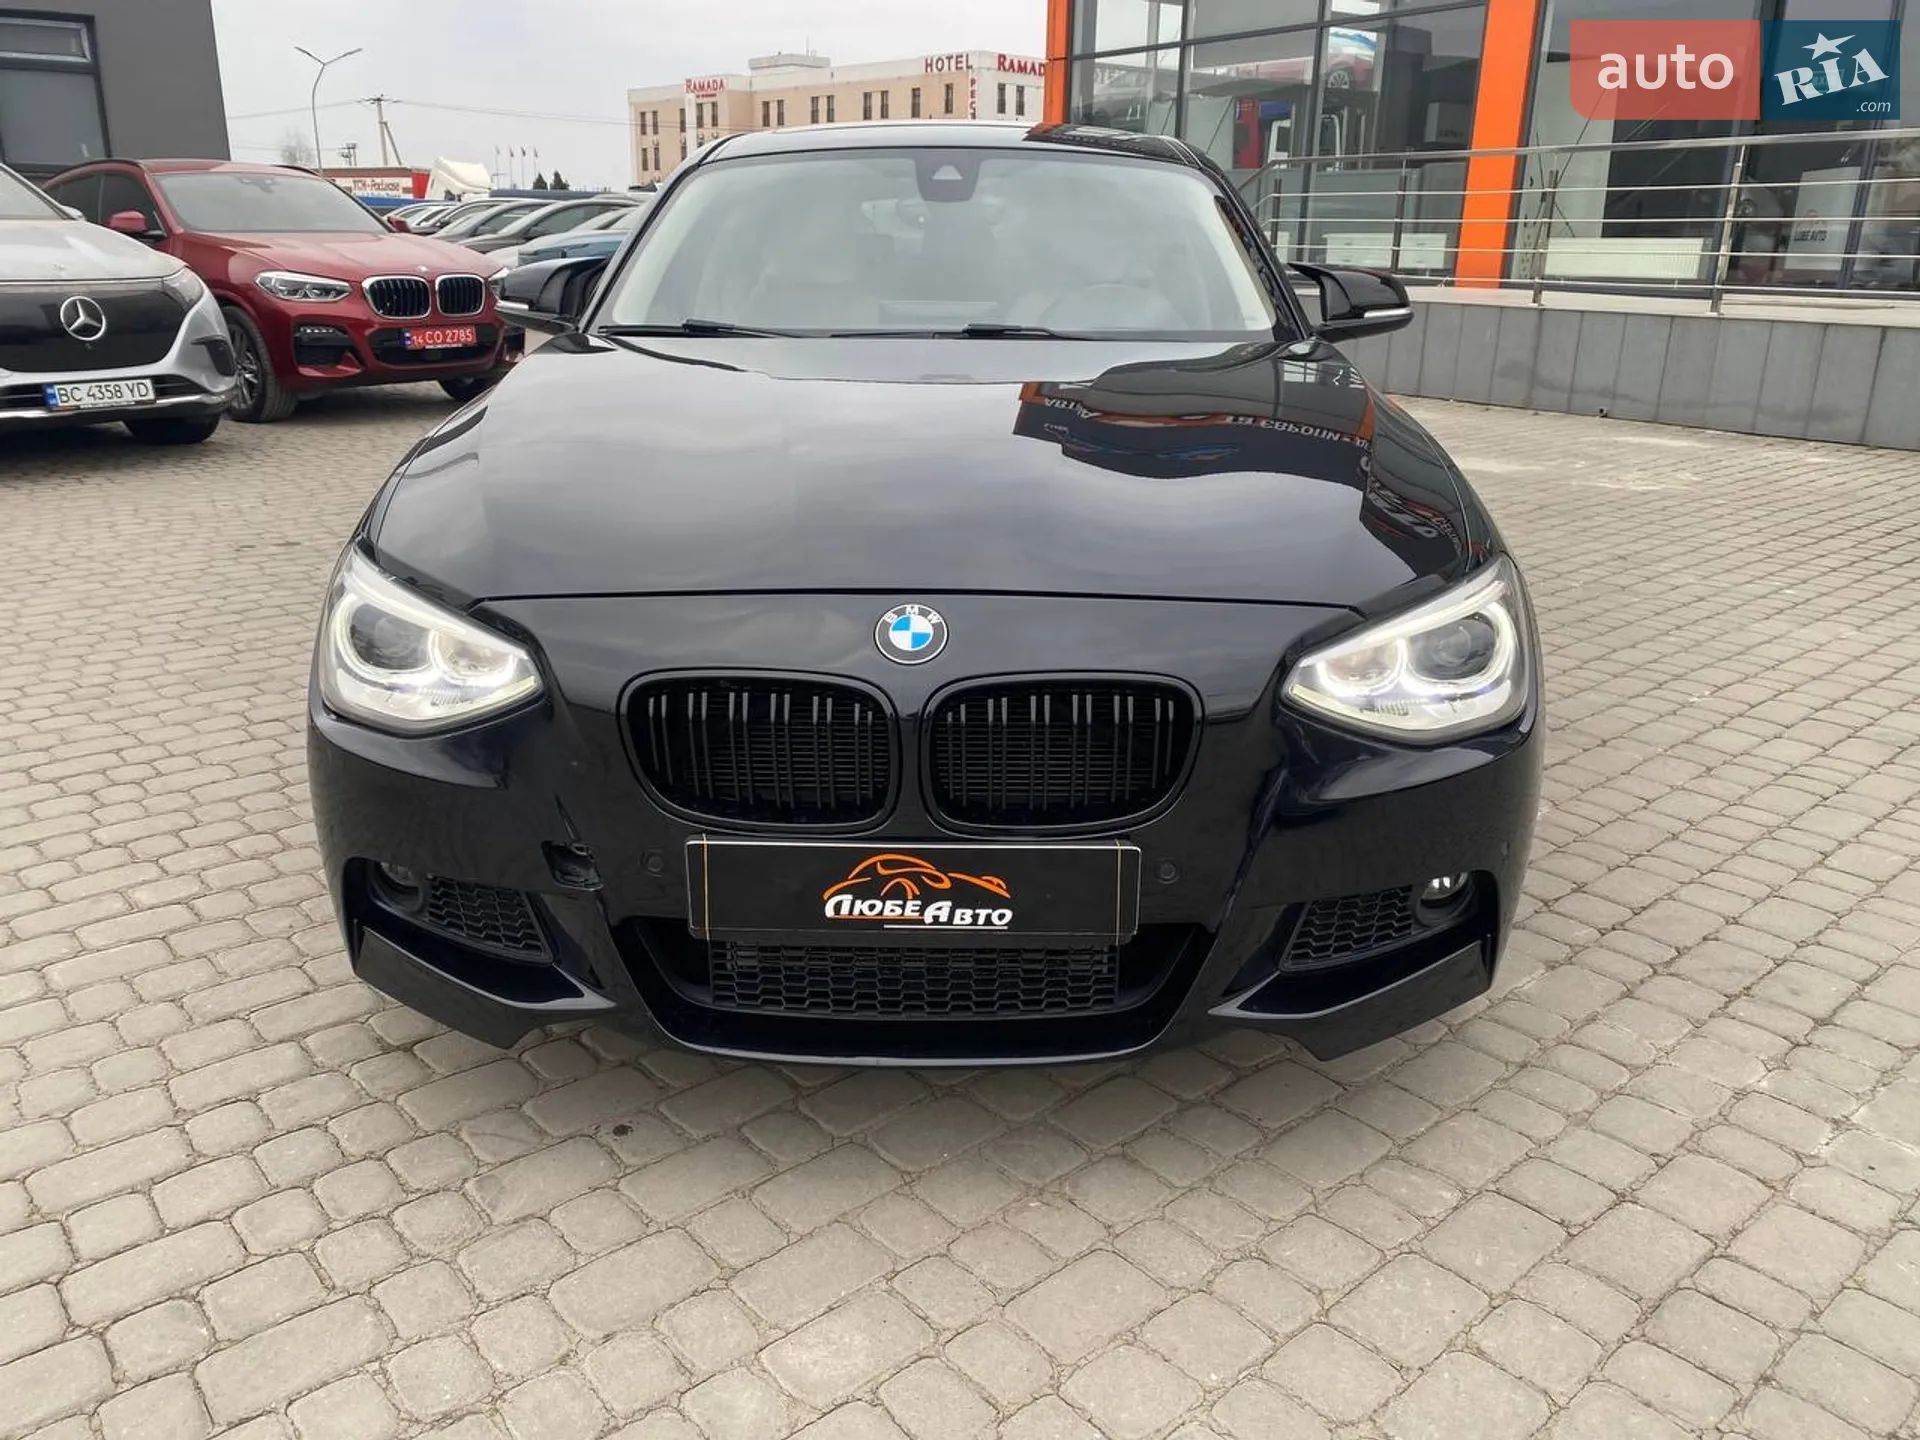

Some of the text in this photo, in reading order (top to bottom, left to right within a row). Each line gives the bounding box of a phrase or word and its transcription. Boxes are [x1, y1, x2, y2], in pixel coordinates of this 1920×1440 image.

[925, 53, 974, 73] HOTEL
[685, 78, 725, 94] RAMADA
[425, 331, 443, 344] CO
[445, 328, 473, 342] 2785
[57, 382, 149, 404] BC 4358 YD
[883, 604, 941, 624] BMW
